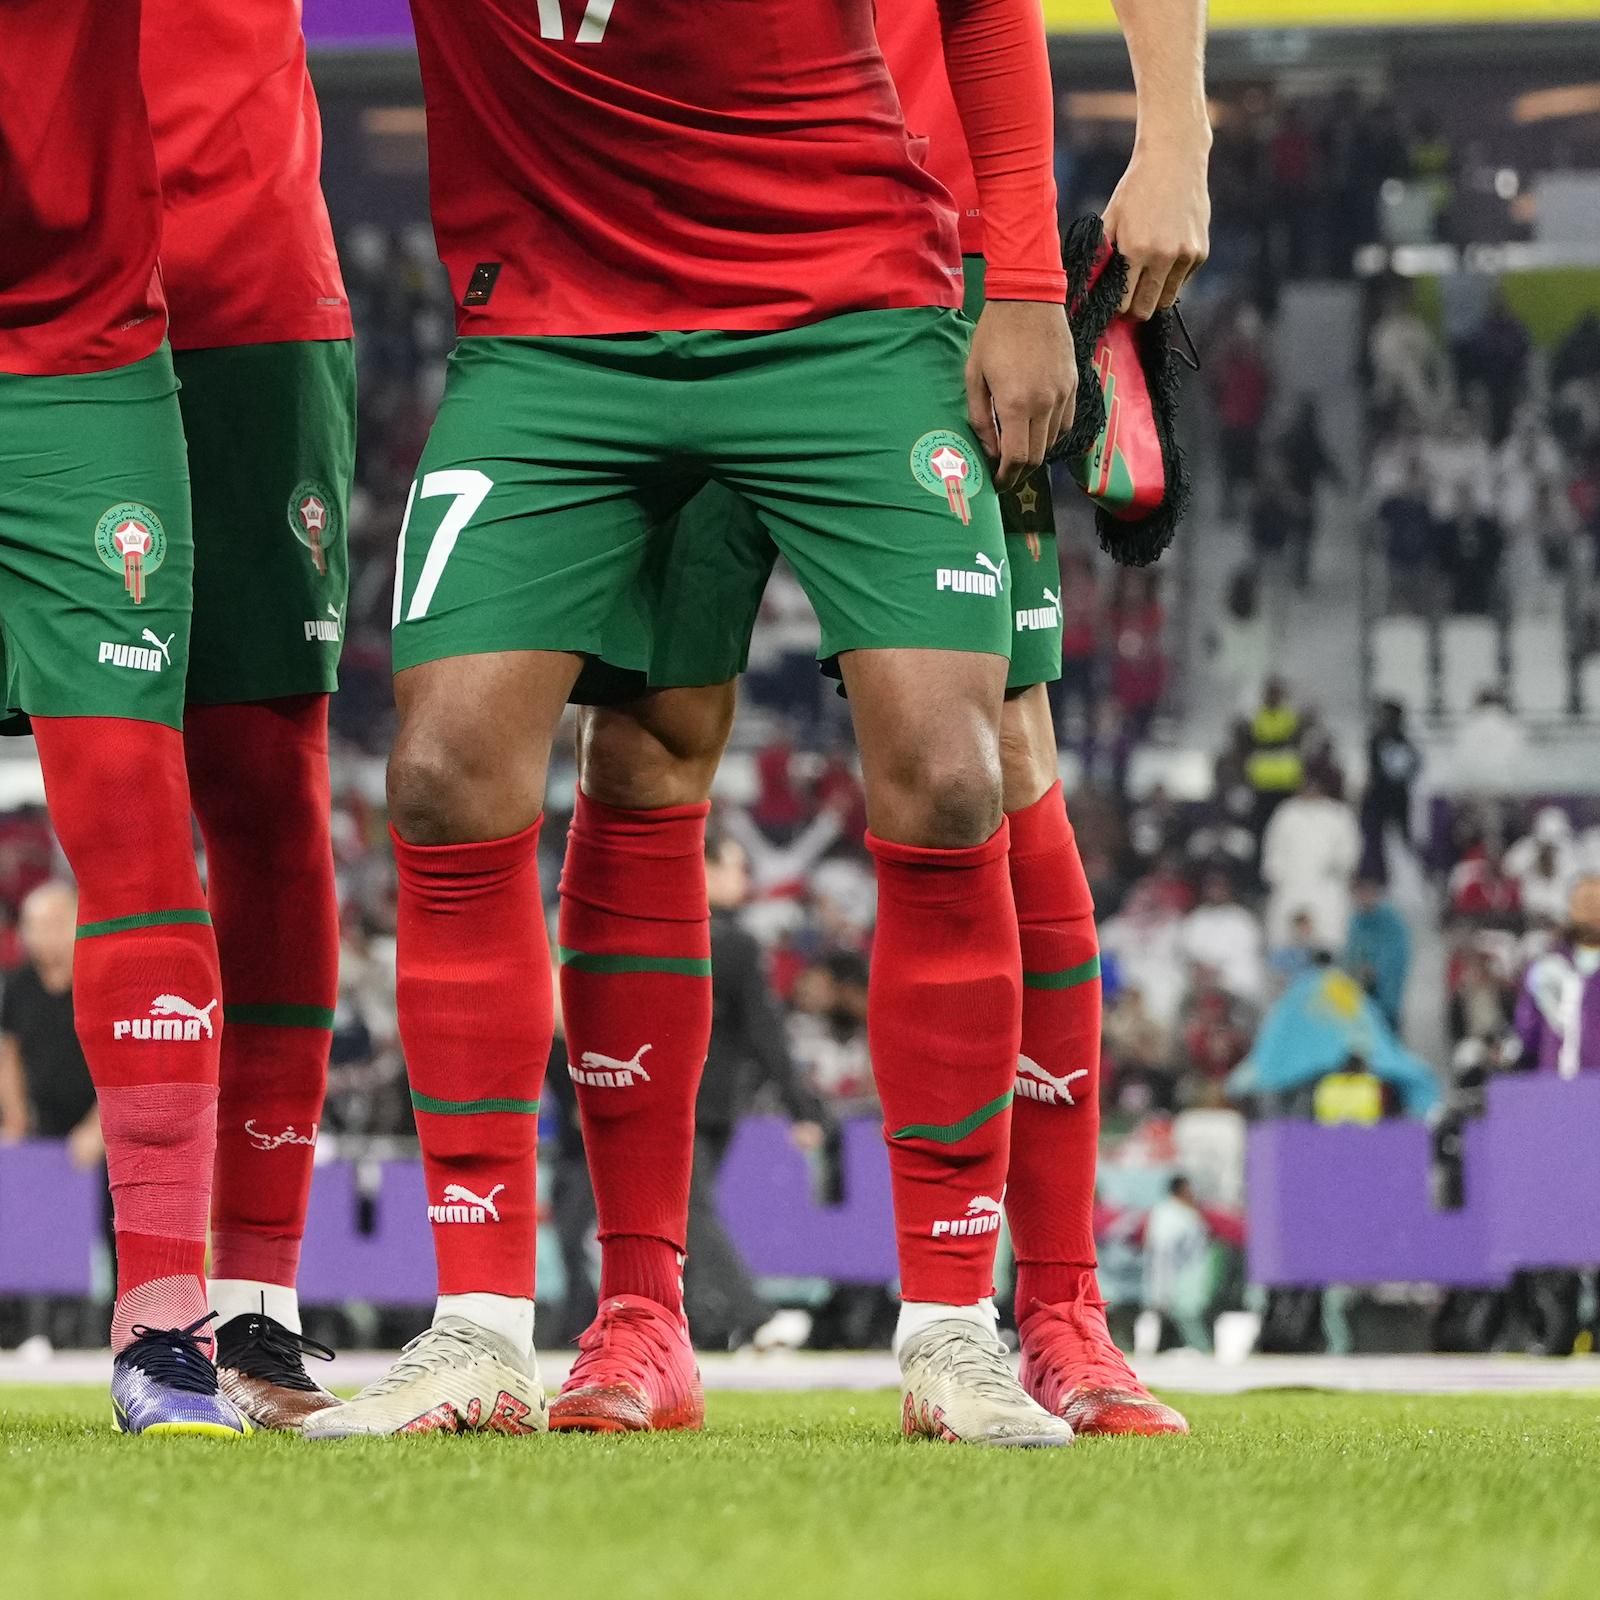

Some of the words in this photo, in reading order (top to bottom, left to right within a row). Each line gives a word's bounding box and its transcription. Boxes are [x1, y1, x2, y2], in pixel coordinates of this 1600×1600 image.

[936, 568, 997, 597] PUMA
[304, 620, 342, 642] PUMA
[1015, 607, 1057, 632] PUMA
[98, 640, 162, 672] PUMA
[114, 1017, 203, 1041] PUMA
[932, 1215, 999, 1239] PUMA
[394, 1390, 537, 1435] AIR
